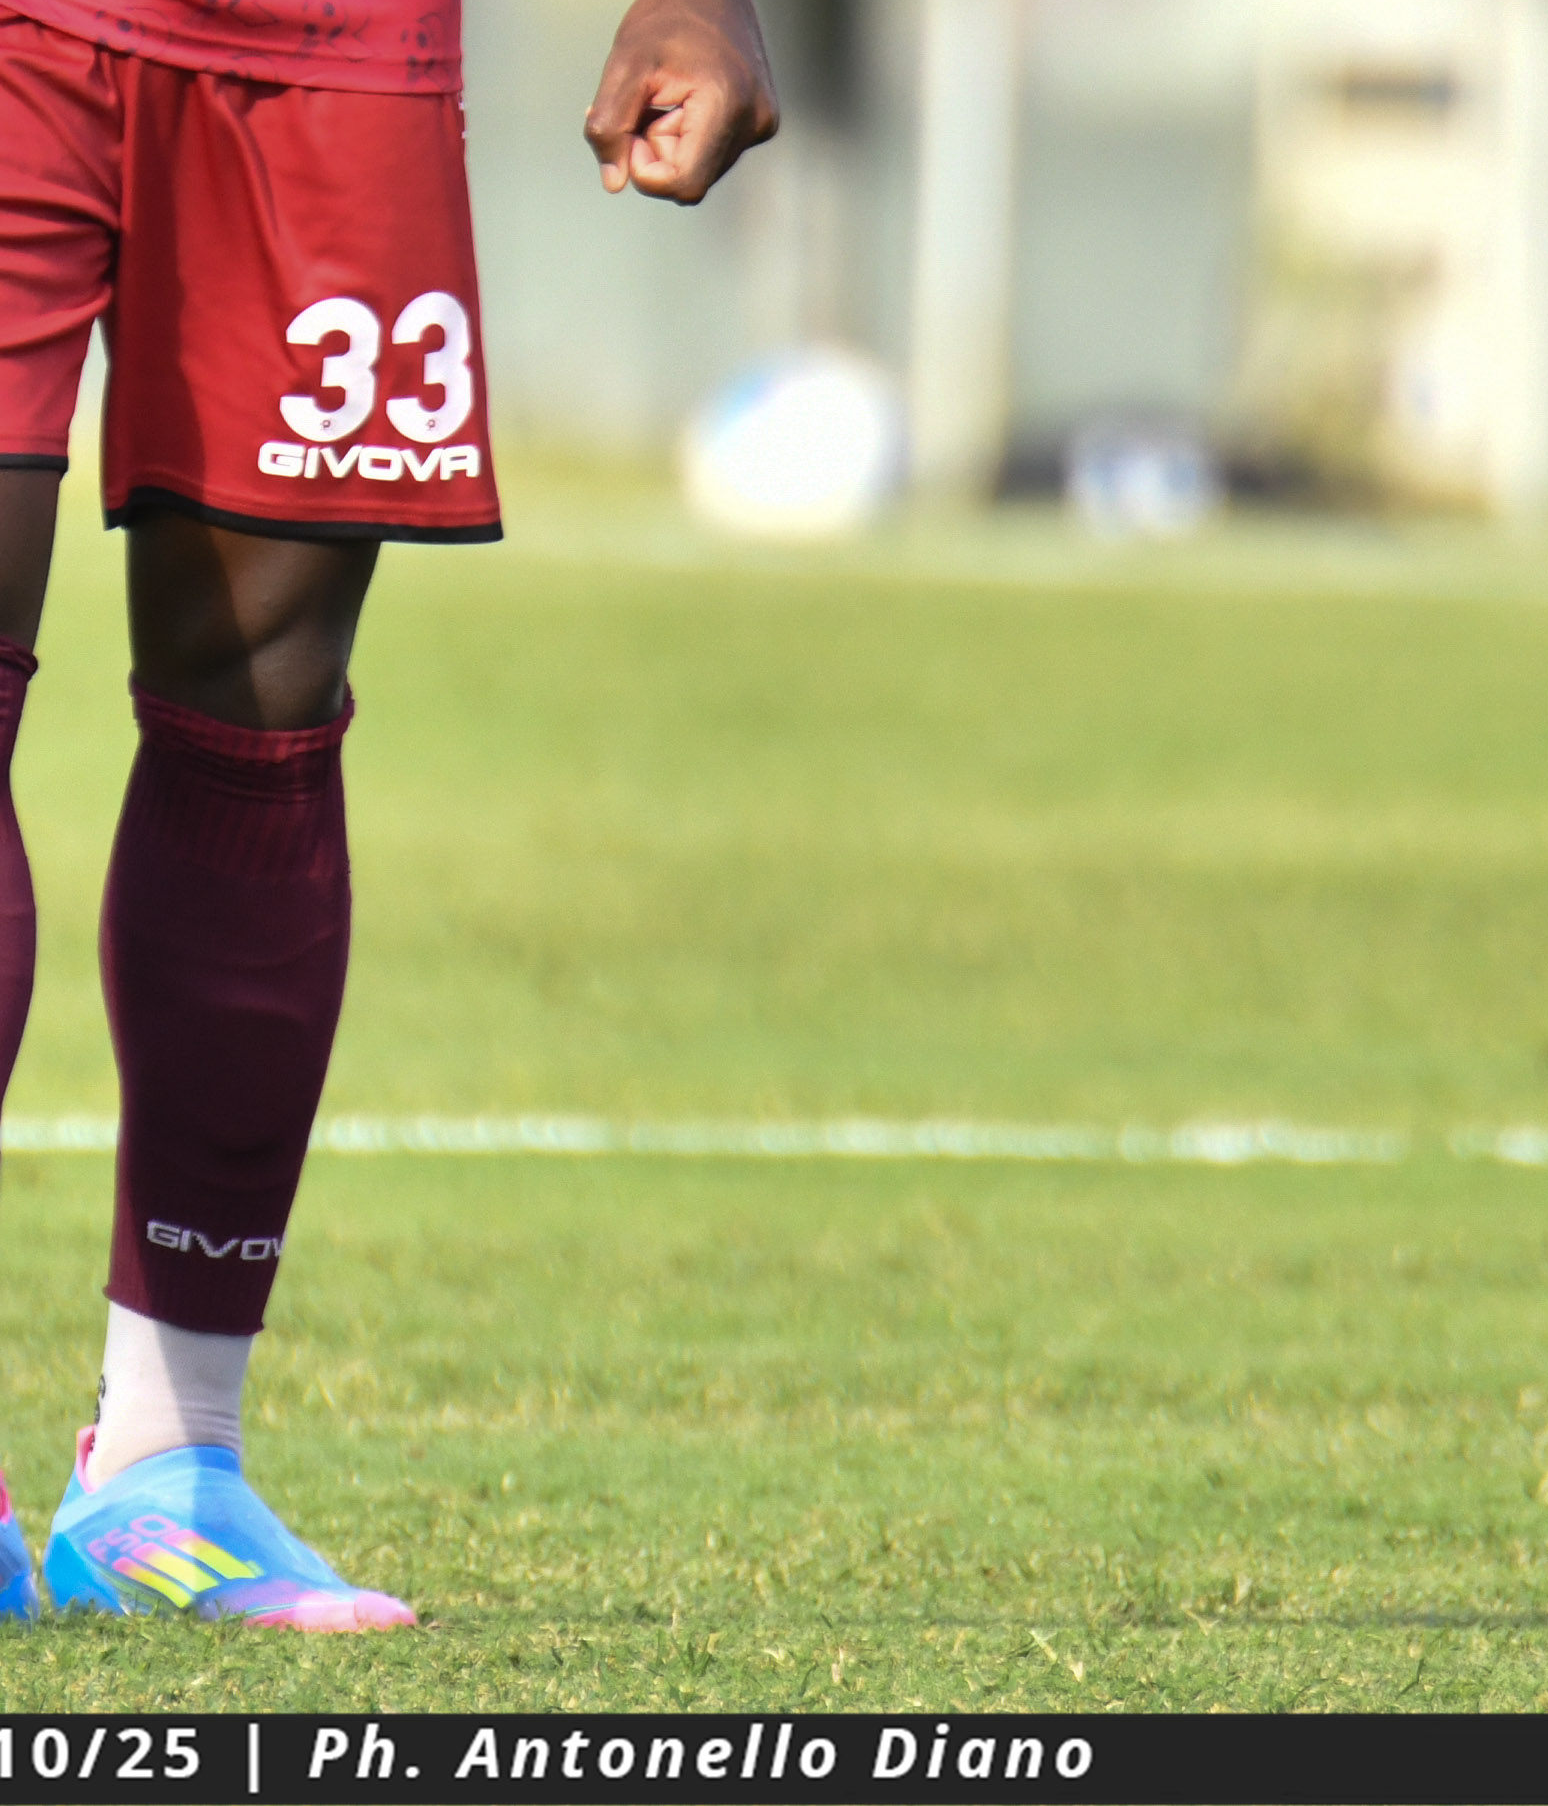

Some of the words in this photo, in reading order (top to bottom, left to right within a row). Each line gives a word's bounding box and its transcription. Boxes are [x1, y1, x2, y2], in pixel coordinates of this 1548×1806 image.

[279, 291, 473, 443] 33
[257, 439, 481, 482] GIVOVA
[87, 1514, 178, 1564] F50
